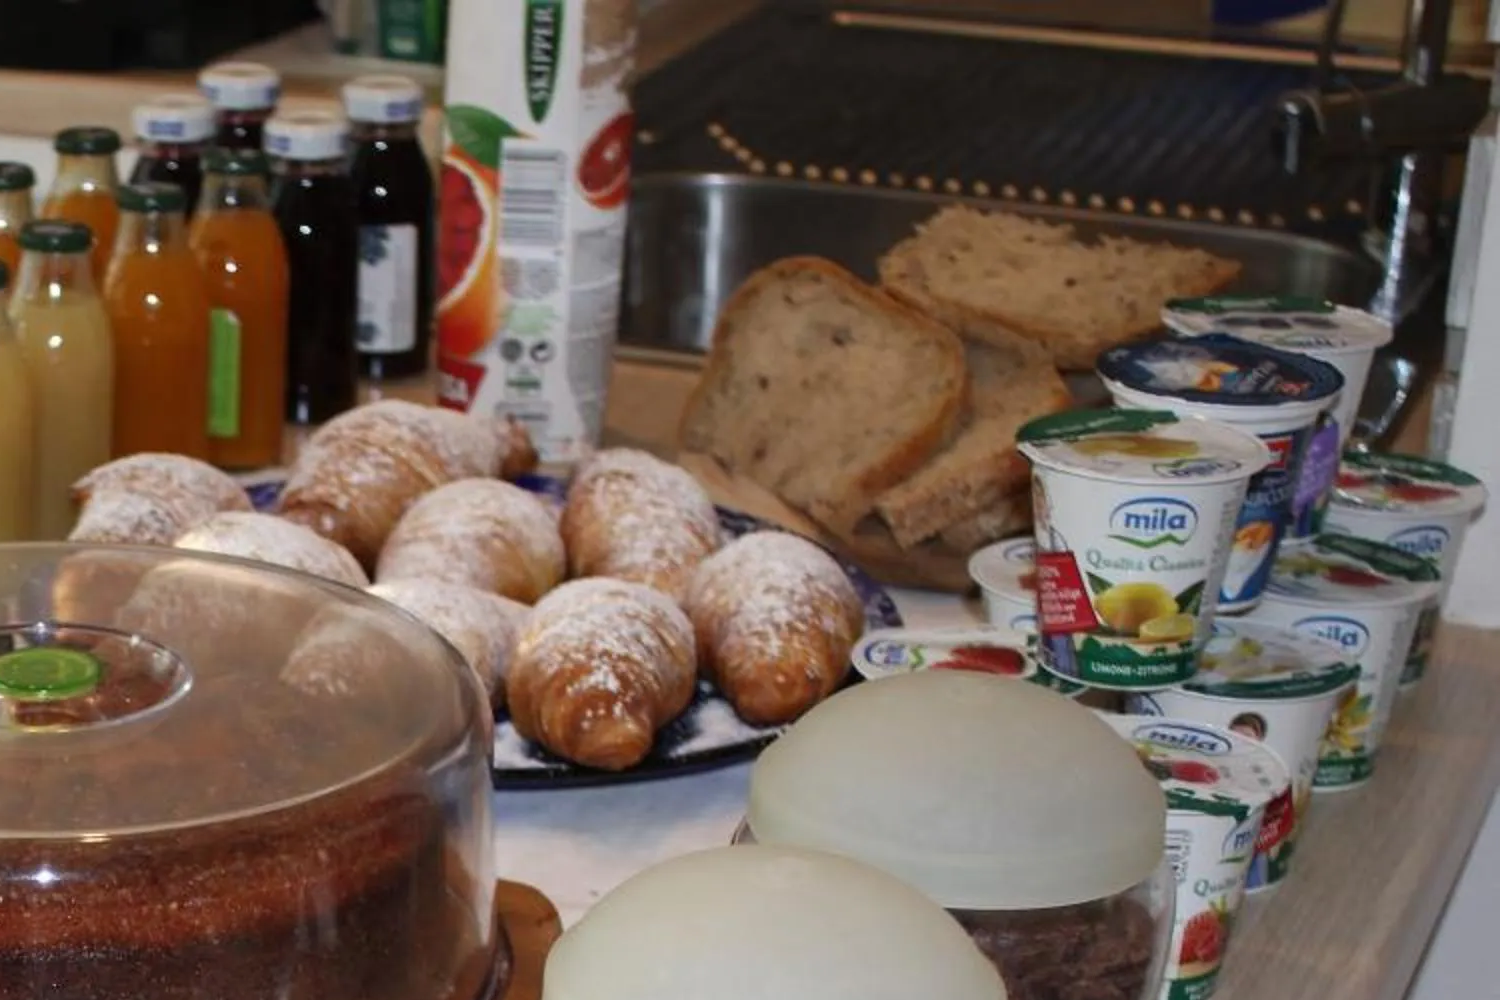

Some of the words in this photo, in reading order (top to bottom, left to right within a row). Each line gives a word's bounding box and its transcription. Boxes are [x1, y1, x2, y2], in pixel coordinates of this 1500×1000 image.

[530, 7, 553, 101] SKIPPER
[1124, 508, 1187, 531] mila
[1150, 731, 1216, 751] mila
